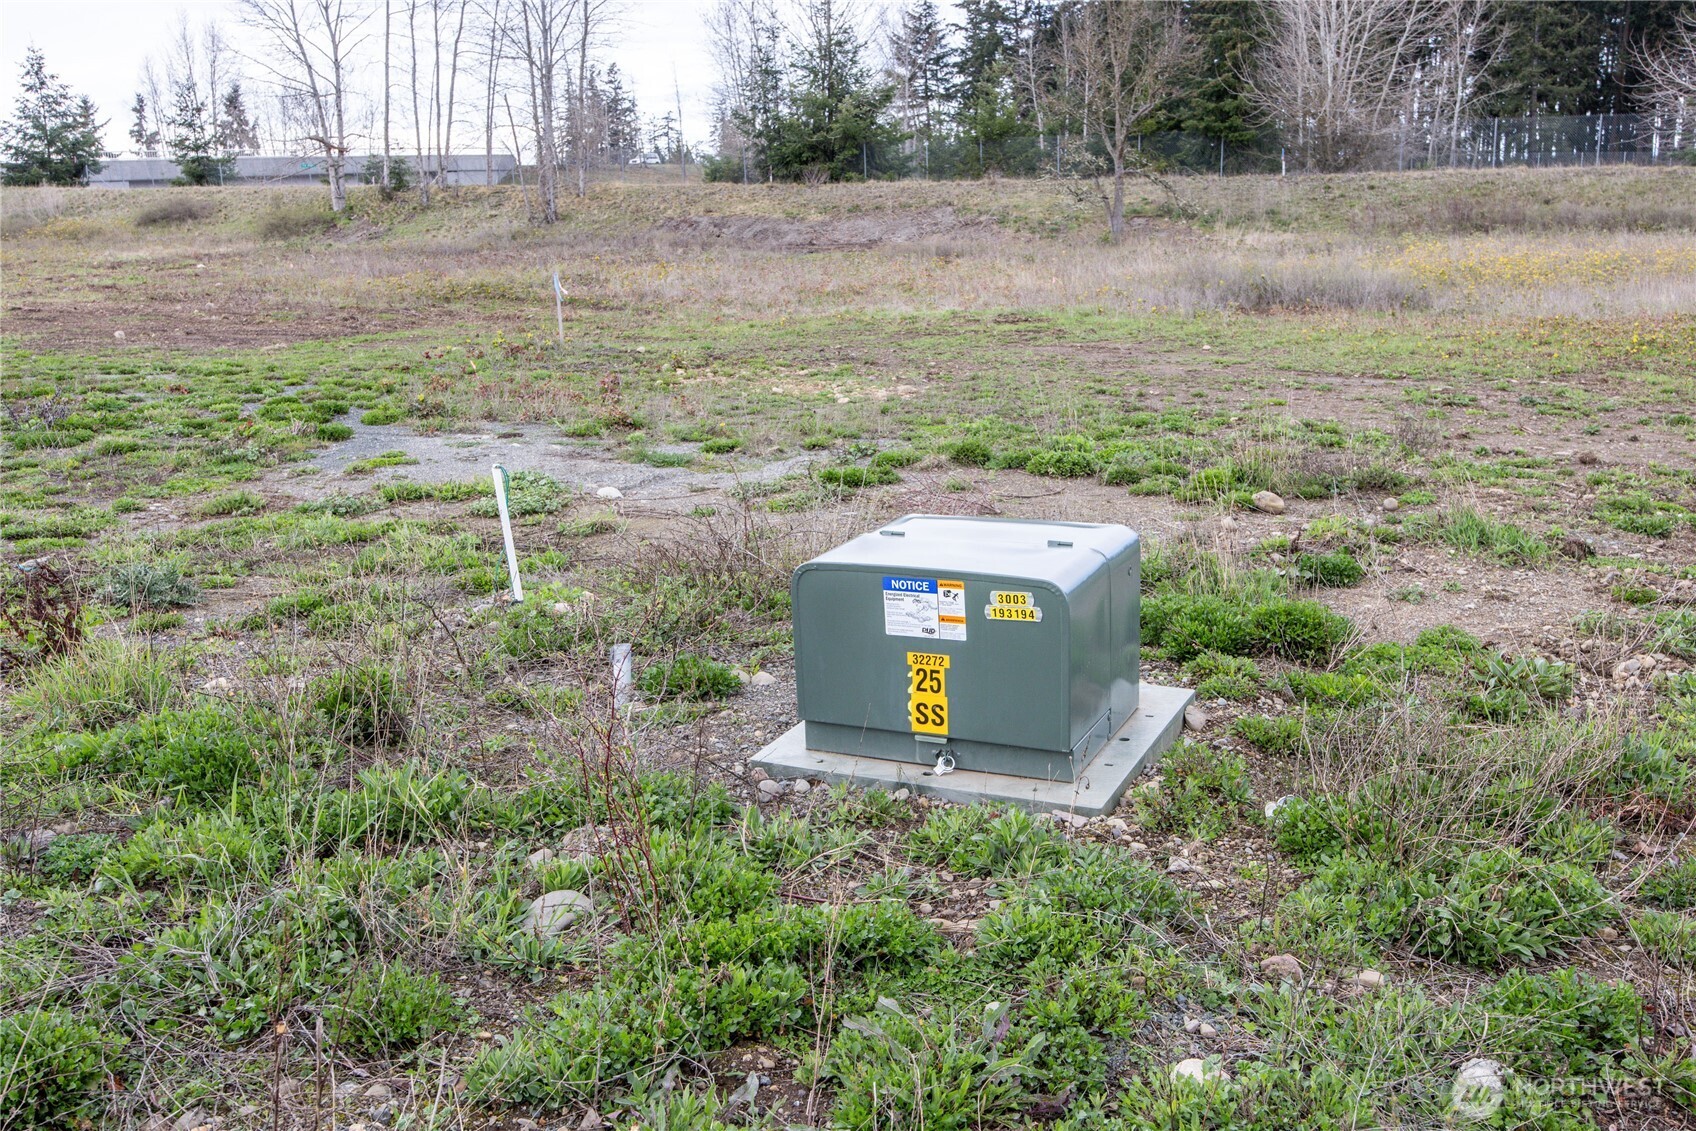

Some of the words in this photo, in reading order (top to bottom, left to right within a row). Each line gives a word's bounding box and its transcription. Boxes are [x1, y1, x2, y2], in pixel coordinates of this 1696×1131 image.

[891, 579, 930, 591] NOTICE
[997, 594, 1026, 605] 3003
[992, 608, 1035, 620] 193194
[912, 654, 945, 667] 32272
[915, 668, 942, 694] 25
[915, 702, 945, 727] SS
